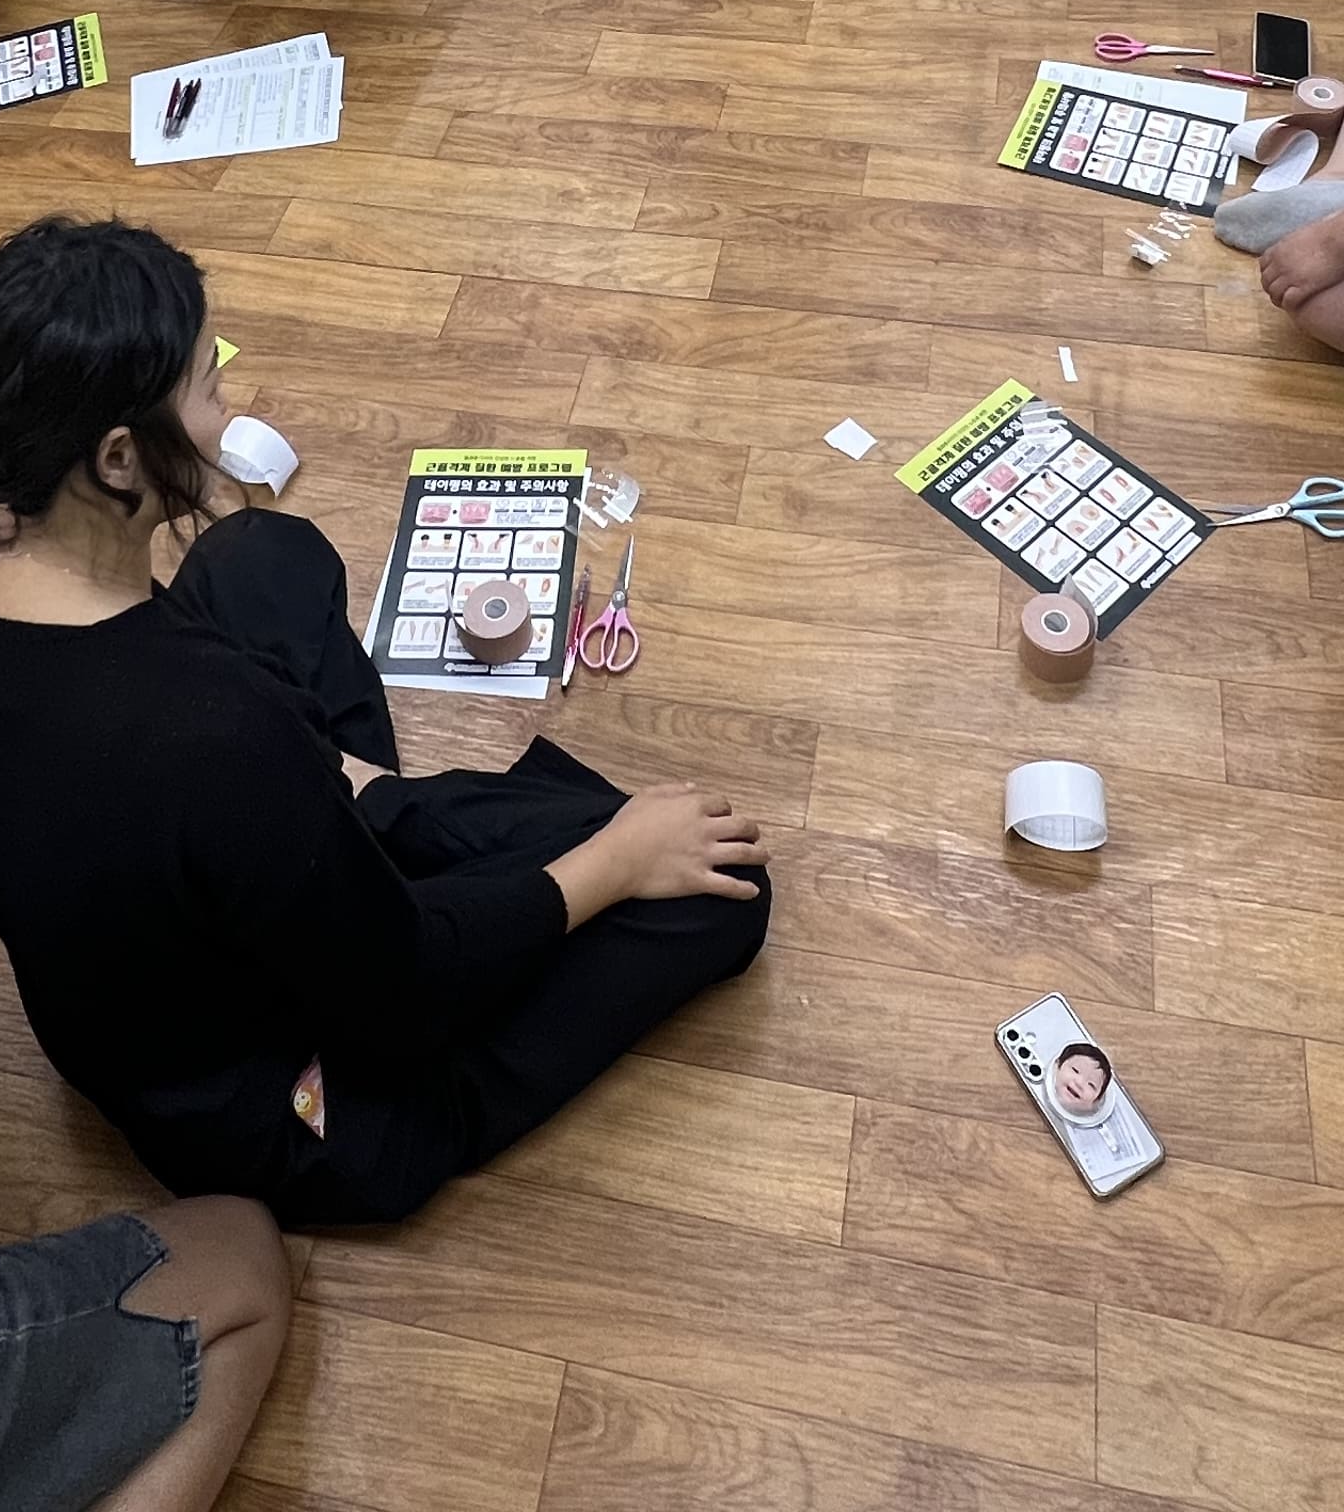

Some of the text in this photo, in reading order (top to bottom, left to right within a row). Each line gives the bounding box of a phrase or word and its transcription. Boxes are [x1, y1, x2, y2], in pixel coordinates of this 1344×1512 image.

[987, 394, 1022, 423] 프로그램
[1001, 416, 1023, 438] 주의
[425, 462, 470, 472] 근골격계
[500, 462, 523, 472] 예방
[527, 463, 572, 472] 프로그램
[423, 479, 569, 492] 테이핑의 효과 및 주의사항
